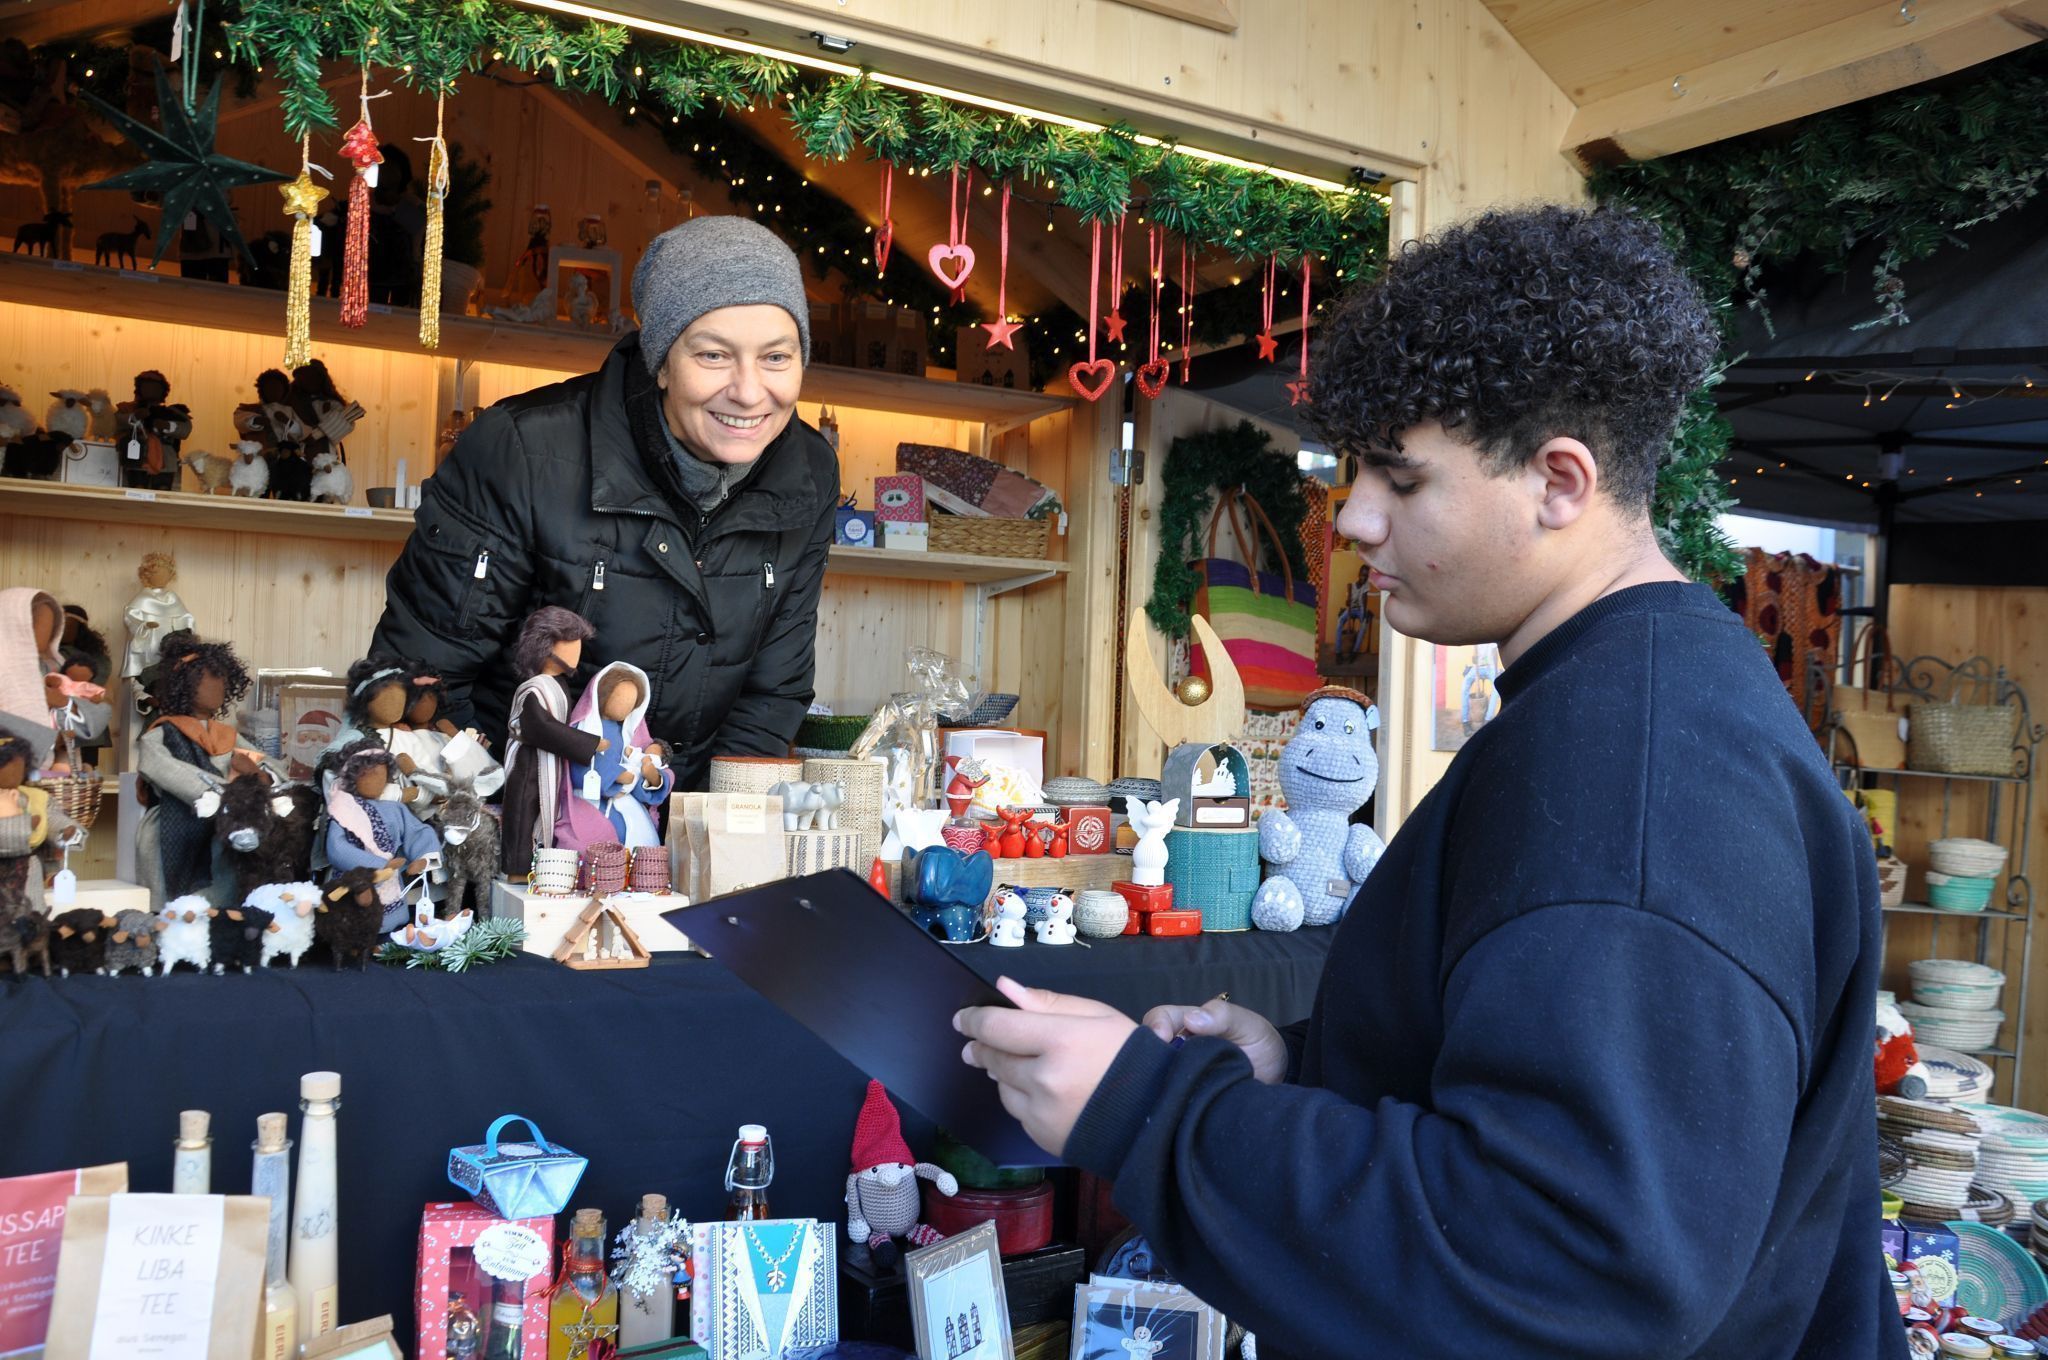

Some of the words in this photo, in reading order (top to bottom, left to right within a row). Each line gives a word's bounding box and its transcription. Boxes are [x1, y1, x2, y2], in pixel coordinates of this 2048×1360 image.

[132, 1224, 200, 1247] KINKE
[4, 1239, 45, 1267] TEE
[136, 1258, 185, 1281] LIBA
[139, 1292, 180, 1315] TEE
